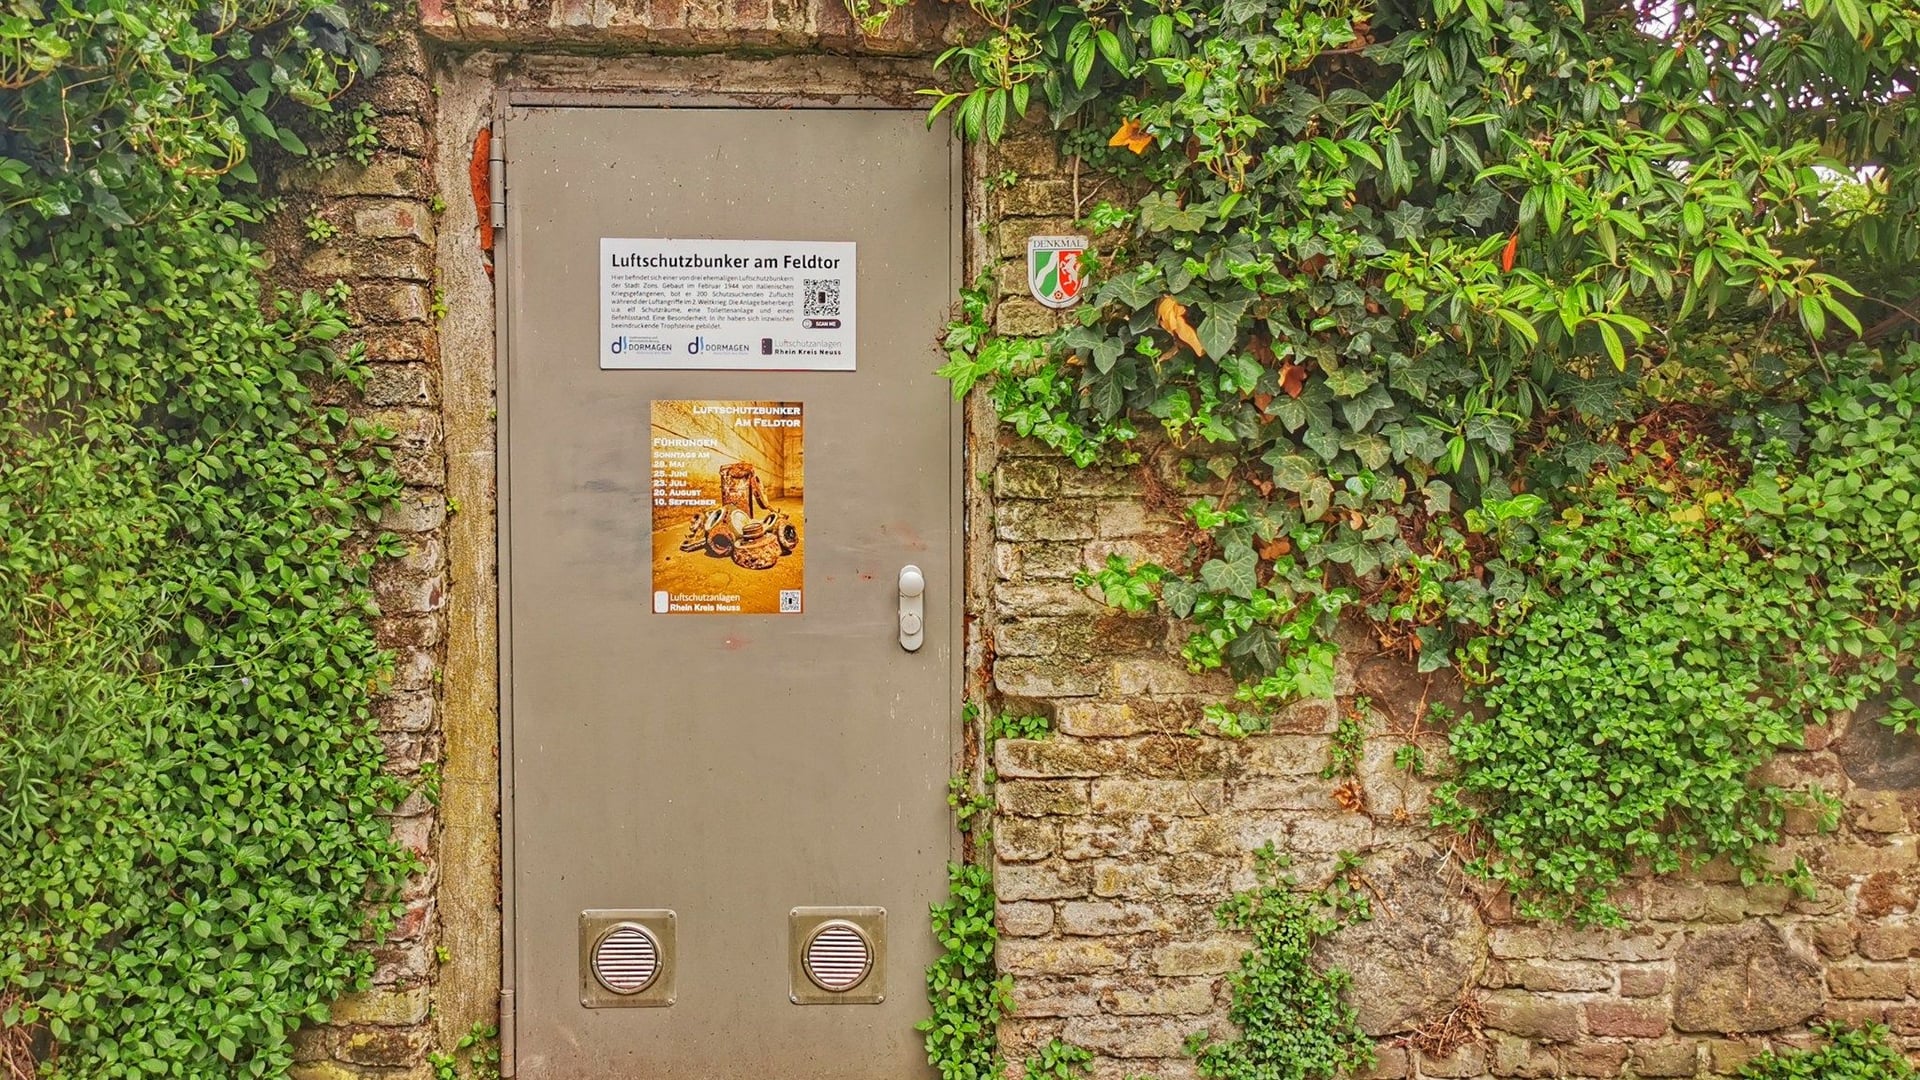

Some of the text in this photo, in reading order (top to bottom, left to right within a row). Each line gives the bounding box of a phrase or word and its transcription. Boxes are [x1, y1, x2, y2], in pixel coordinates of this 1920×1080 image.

[1033, 239, 1083, 248] DENKMAL
[612, 252, 840, 269] Luftschutzbunker am Feldtor
[648, 298, 682, 306] Luftangriffe
[740, 299, 759, 307] Anlage
[761, 299, 794, 307] beherbergt
[707, 307, 754, 315] Toilettenanlage
[774, 339, 842, 349] Luftschutzanlagen
[693, 405, 801, 415] LUFTSCHUTZBUNKER
[735, 418, 801, 427] AM FELDTOR
[653, 437, 717, 447] FÜHRUNGEN
[670, 592, 741, 603] Luftschutzanlagen
[670, 603, 741, 611] Rhein Kreis Neuss
